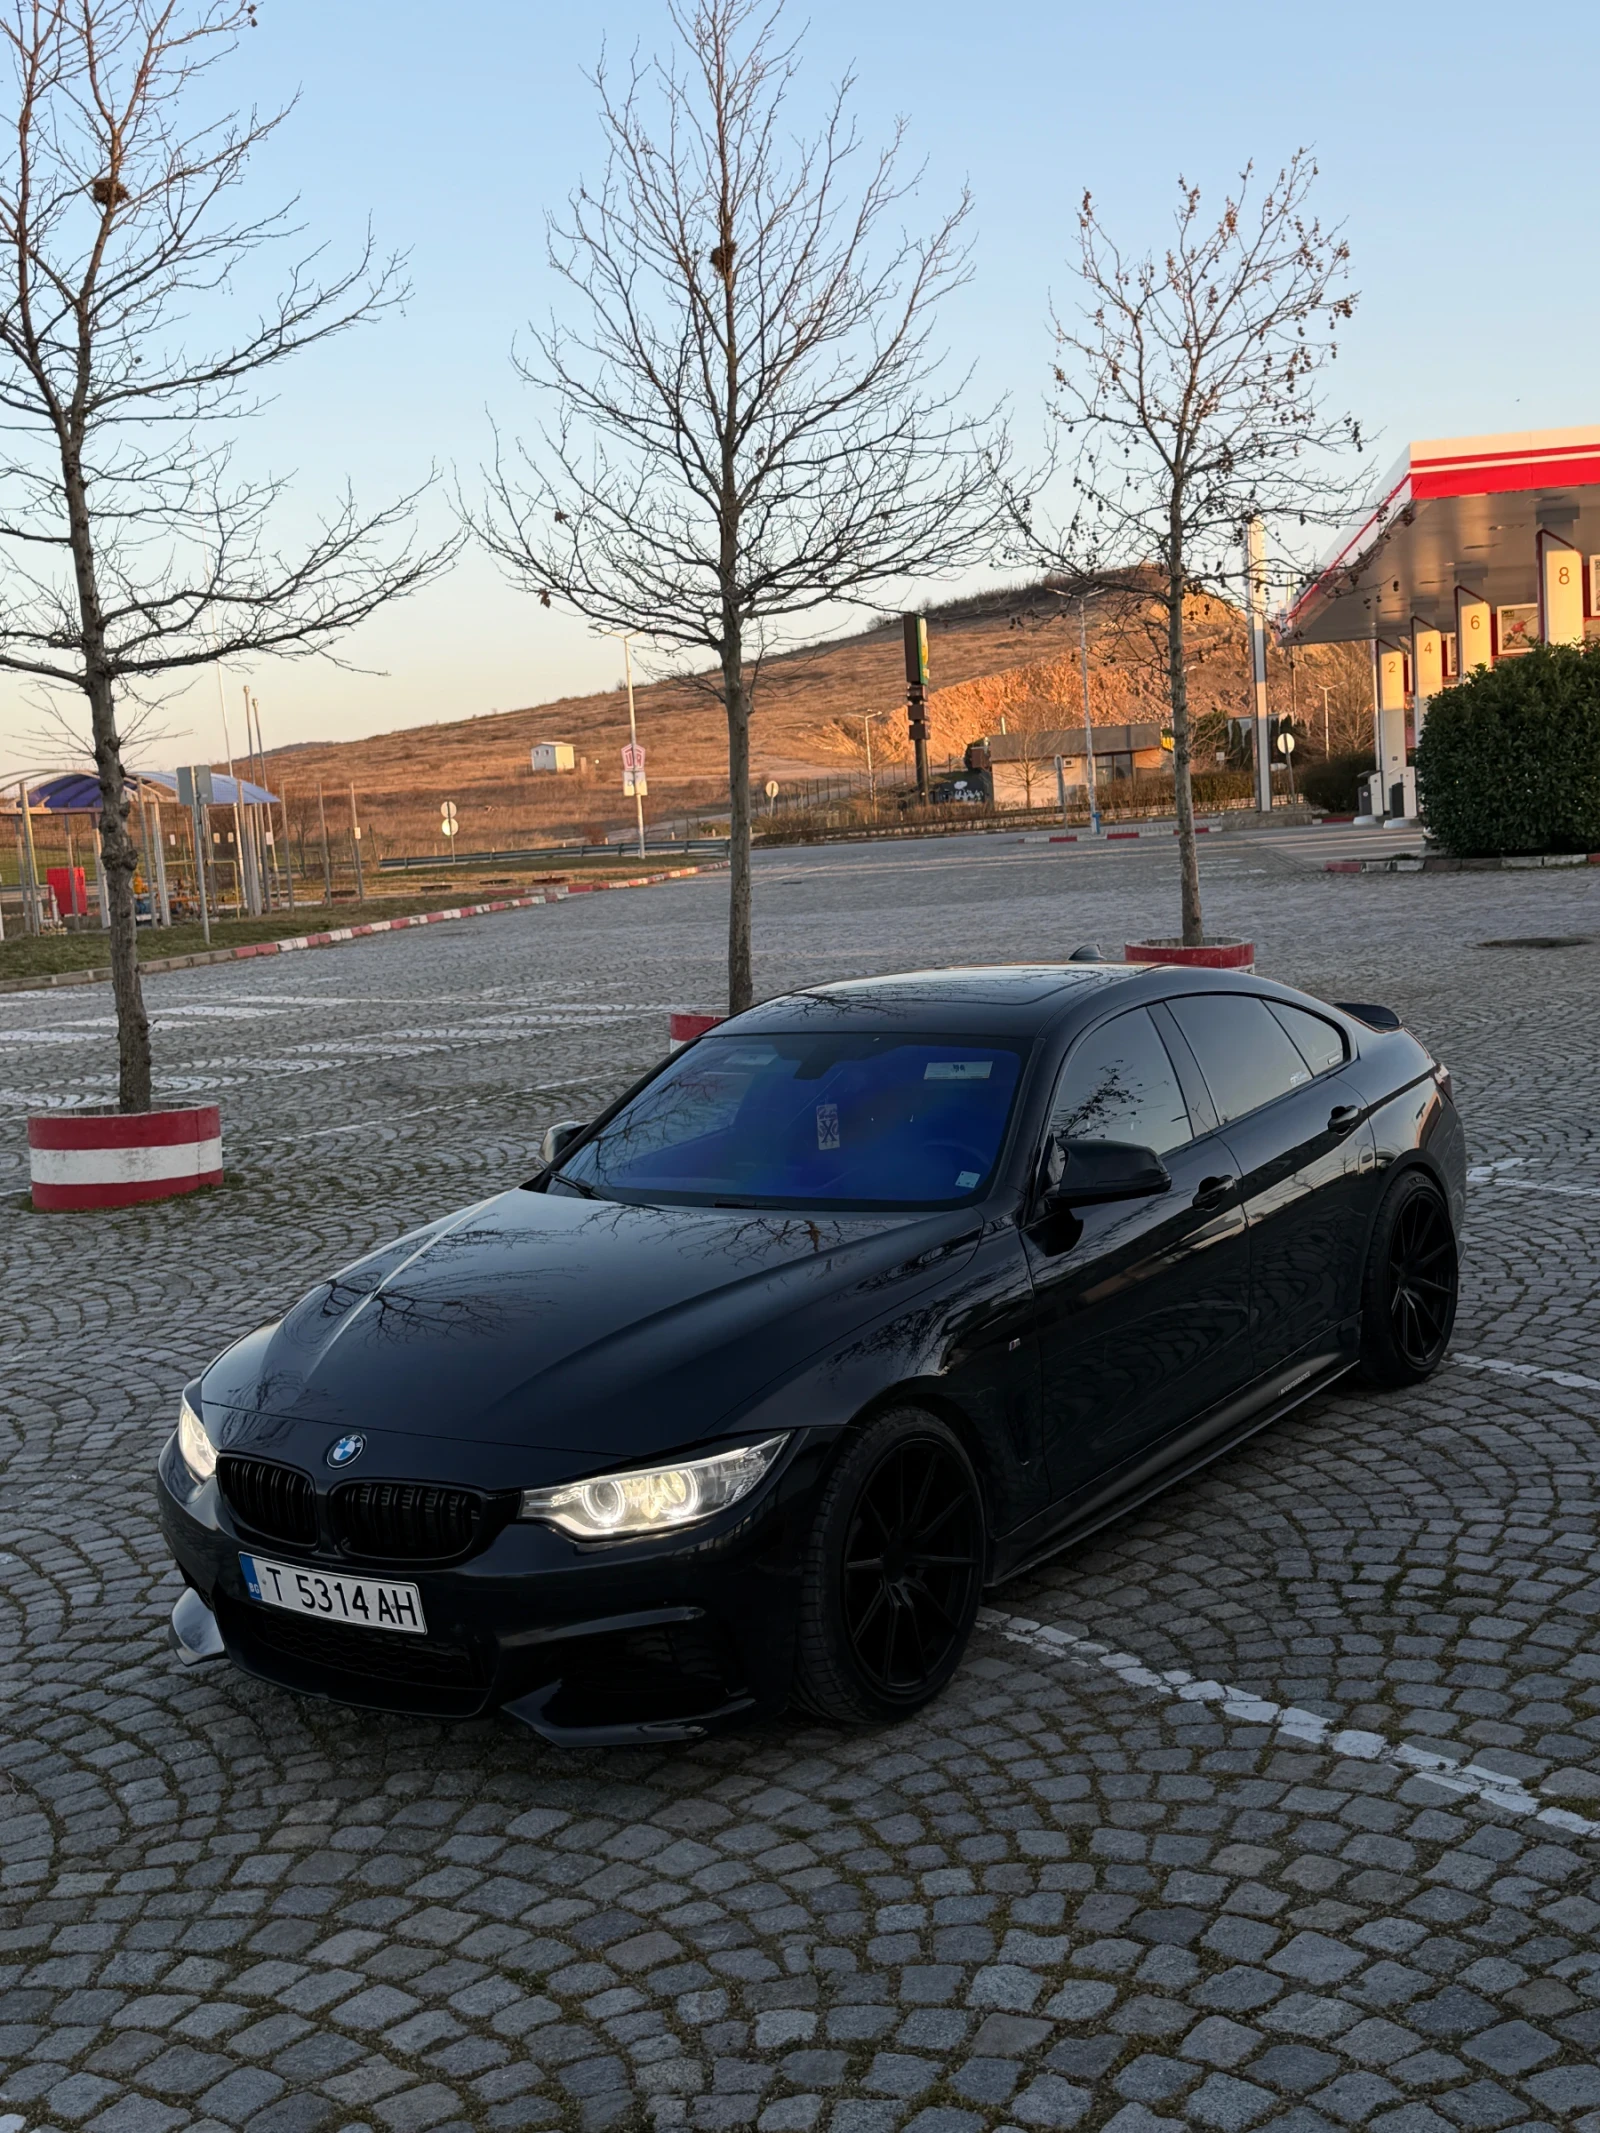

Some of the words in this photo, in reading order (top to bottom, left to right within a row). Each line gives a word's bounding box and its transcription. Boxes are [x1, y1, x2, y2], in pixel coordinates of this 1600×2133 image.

[1558, 566, 1570, 585] 8
[1470, 614, 1480, 630] 6
[1424, 641, 1432, 654] 4
[1388, 661, 1396, 673] 2
[248, 1582, 261, 1594] BG
[266, 1567, 283, 1602] T
[295, 1574, 370, 1620] 5314
[378, 1587, 418, 1627] AH
